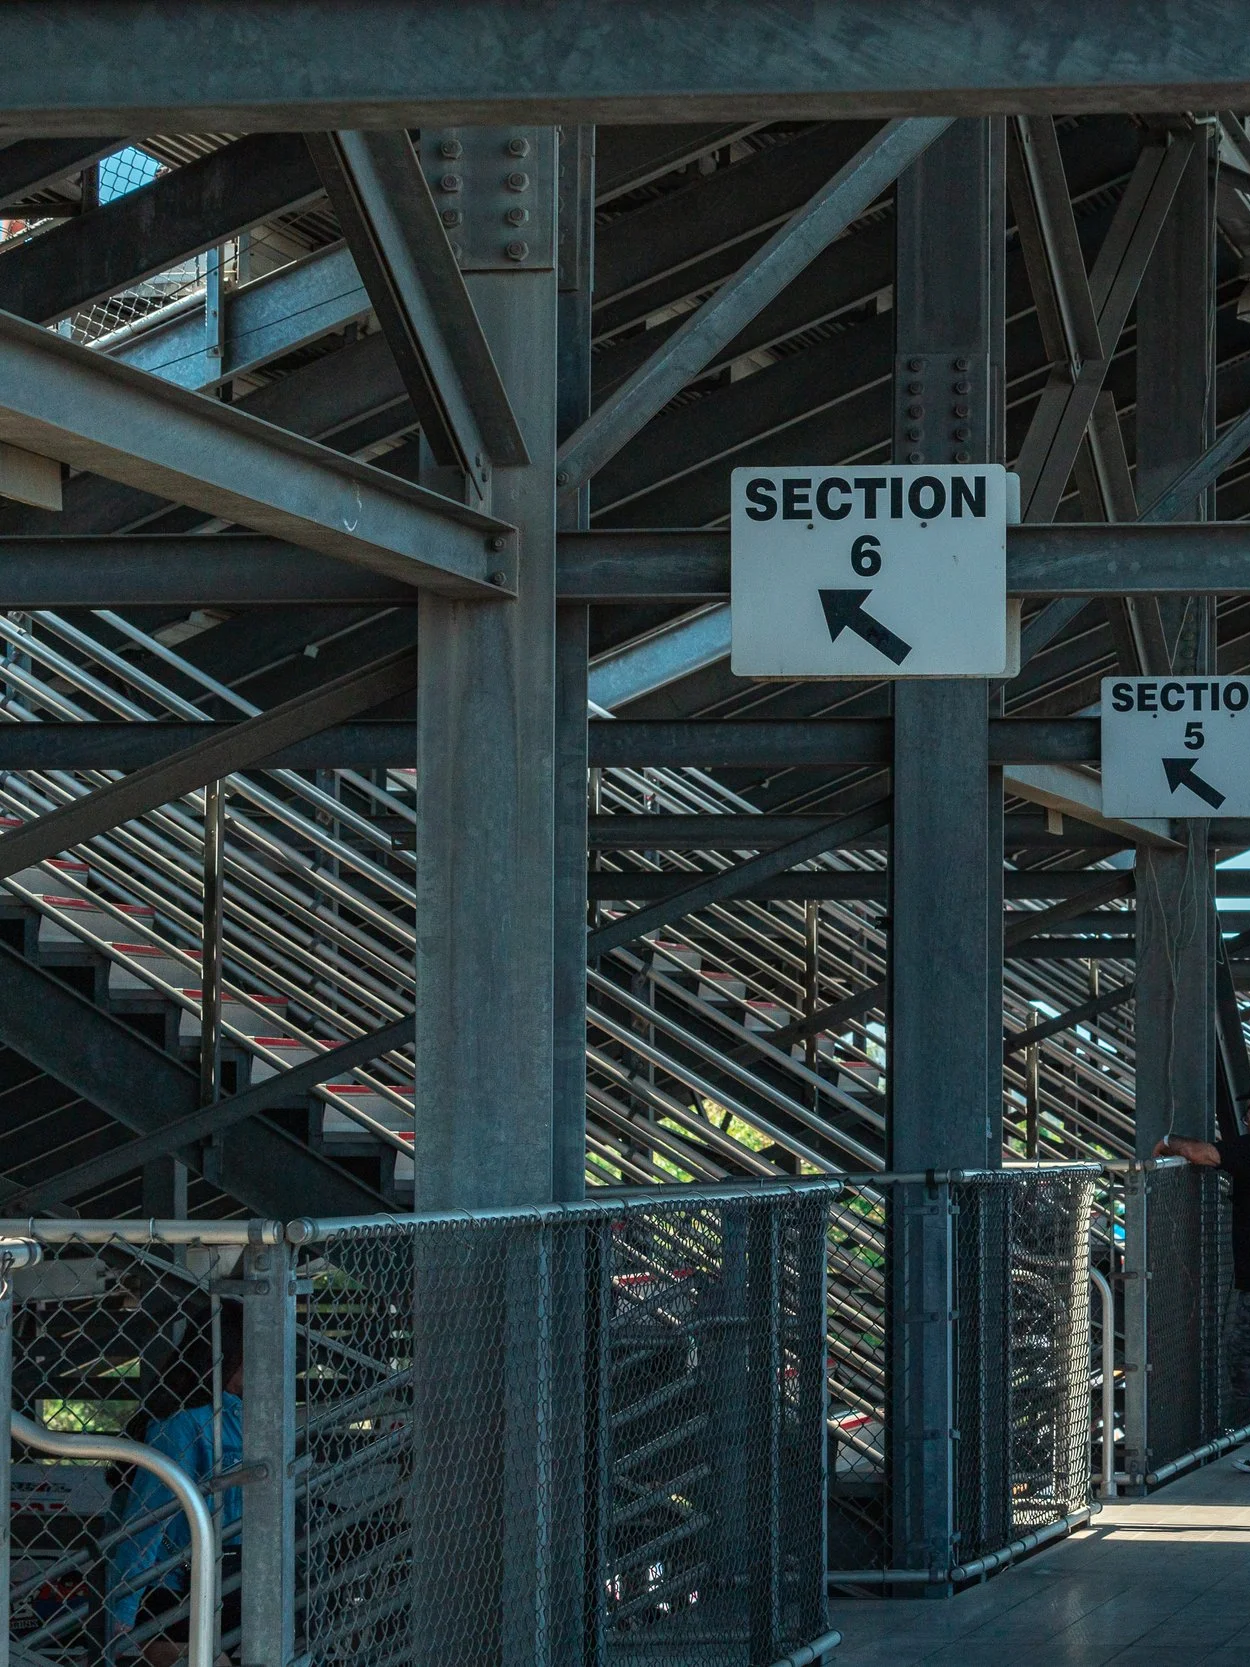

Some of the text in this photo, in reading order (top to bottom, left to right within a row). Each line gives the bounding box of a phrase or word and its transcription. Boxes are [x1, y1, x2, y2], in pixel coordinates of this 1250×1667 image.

[745, 475, 987, 522] SECTION
[850, 534, 882, 577] 6
[1183, 721, 1205, 750] 5
